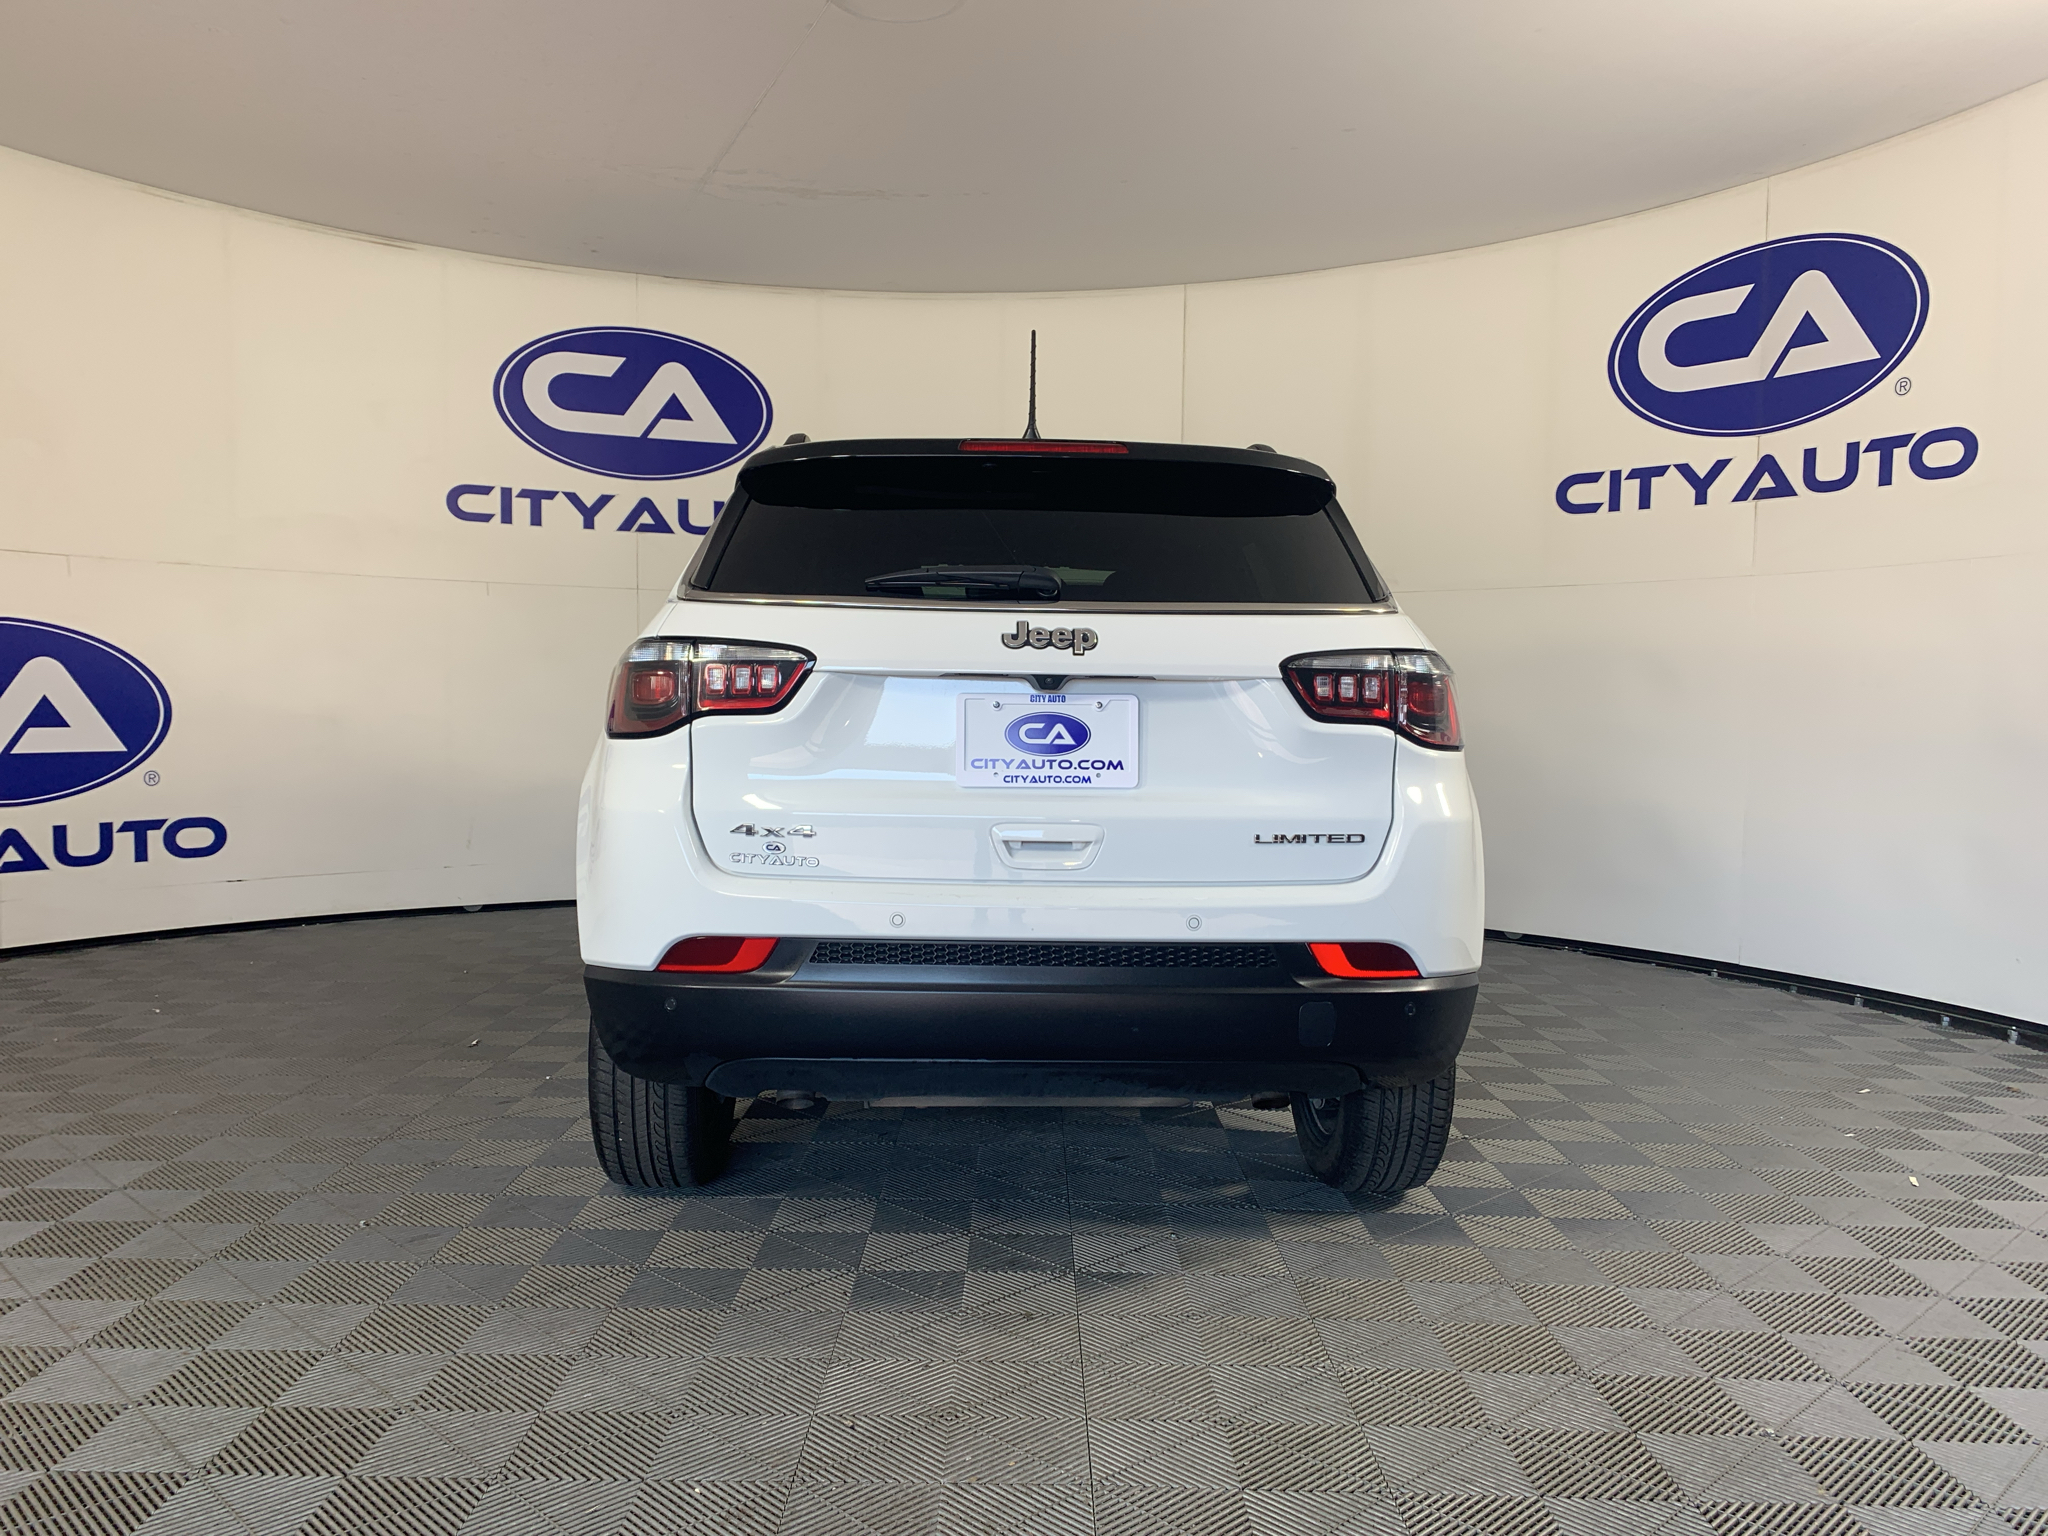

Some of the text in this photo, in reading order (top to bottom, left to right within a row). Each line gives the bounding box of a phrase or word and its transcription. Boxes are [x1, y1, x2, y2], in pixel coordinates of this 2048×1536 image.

[1638, 269, 1881, 393] CA
[522, 351, 738, 444] CA
[1001, 620, 1099, 656] Jeep
[0, 655, 128, 754] A
[1029, 694, 1067, 703] CITY AUTO
[1018, 722, 1078, 746] CA
[970, 758, 1125, 771] CITYAUTO.COM
[1003, 775, 1092, 784] CITYAUTO.COM
[1254, 833, 1366, 844] LIMITED
